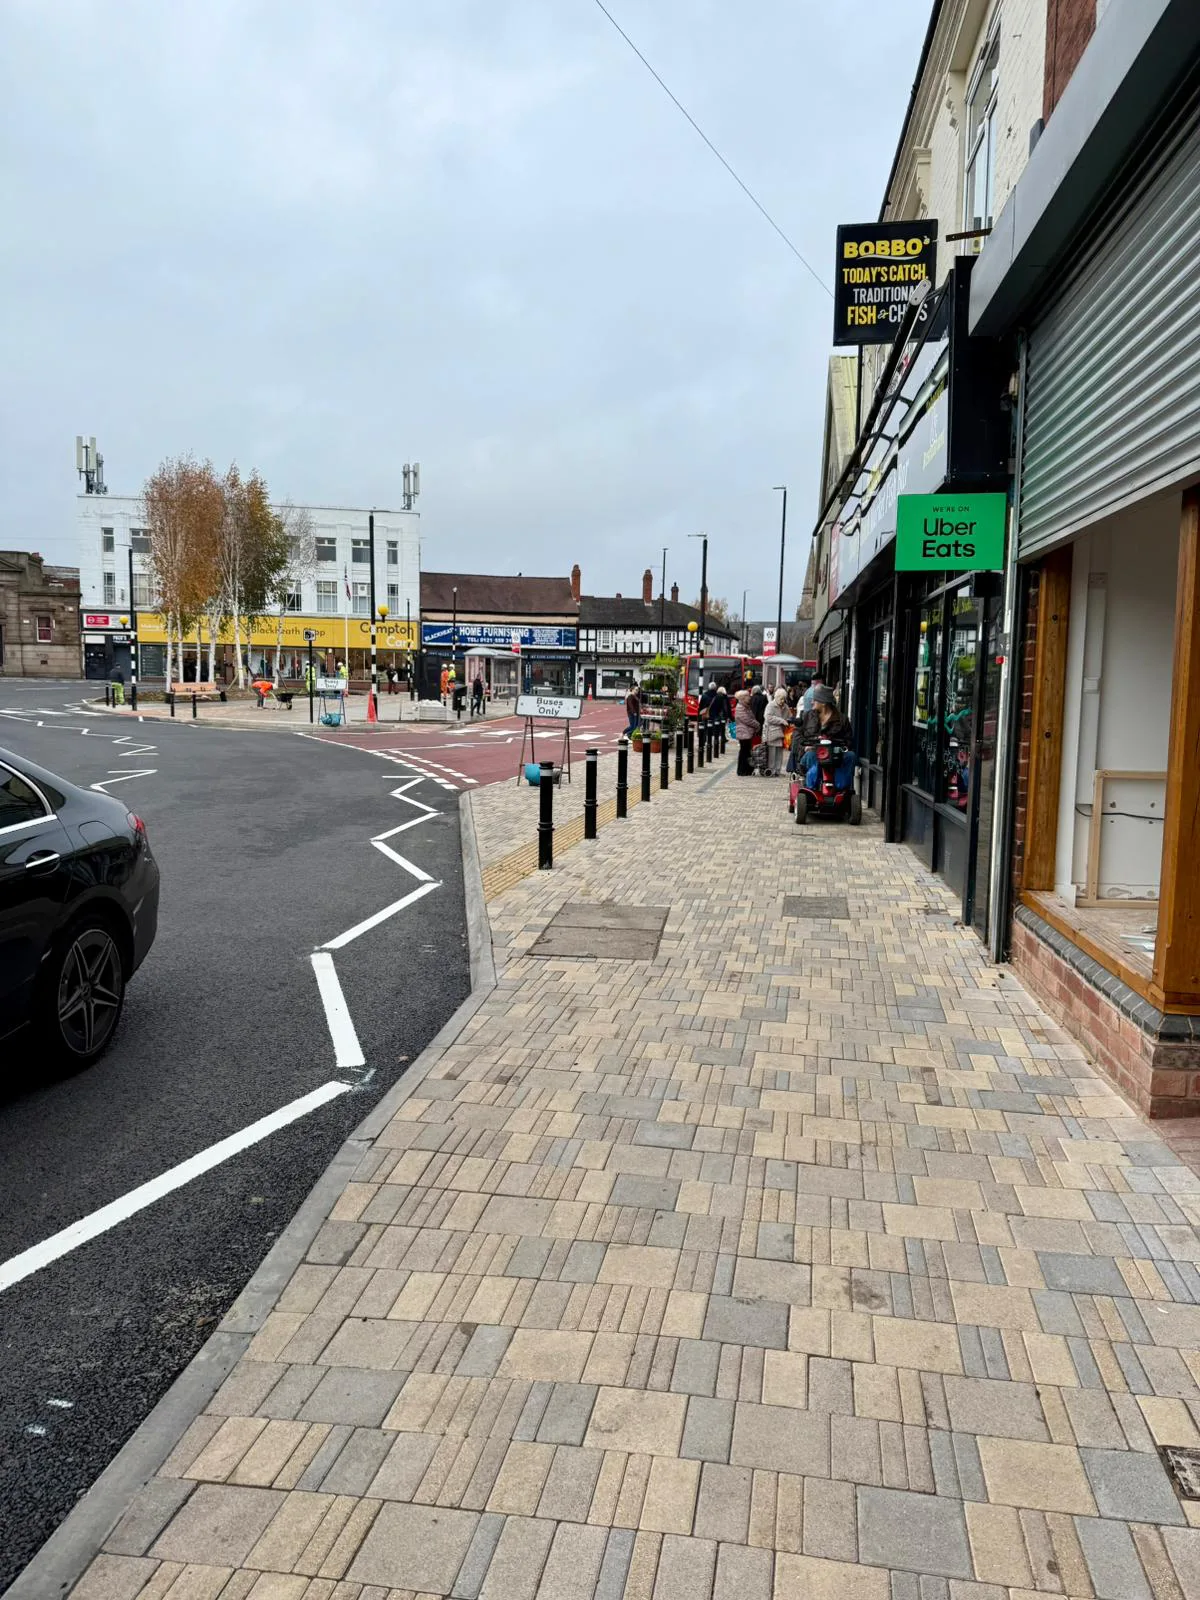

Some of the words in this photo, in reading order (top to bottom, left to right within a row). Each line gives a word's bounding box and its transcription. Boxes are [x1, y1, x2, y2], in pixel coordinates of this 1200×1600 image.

[842, 266, 888, 284] TODAY'S
[853, 285, 918, 304] TRADITIONA
[847, 305, 877, 325] FISH
[877, 308, 889, 320] &
[888, 303, 928, 323] CHS
[958, 505, 970, 513] ON
[923, 517, 977, 536] Uber
[922, 540, 976, 558] Eats
[303, 627, 326, 637] op
[459, 626, 482, 637] HOME
[536, 697, 563, 706] Buses
[538, 706, 560, 717] Only
